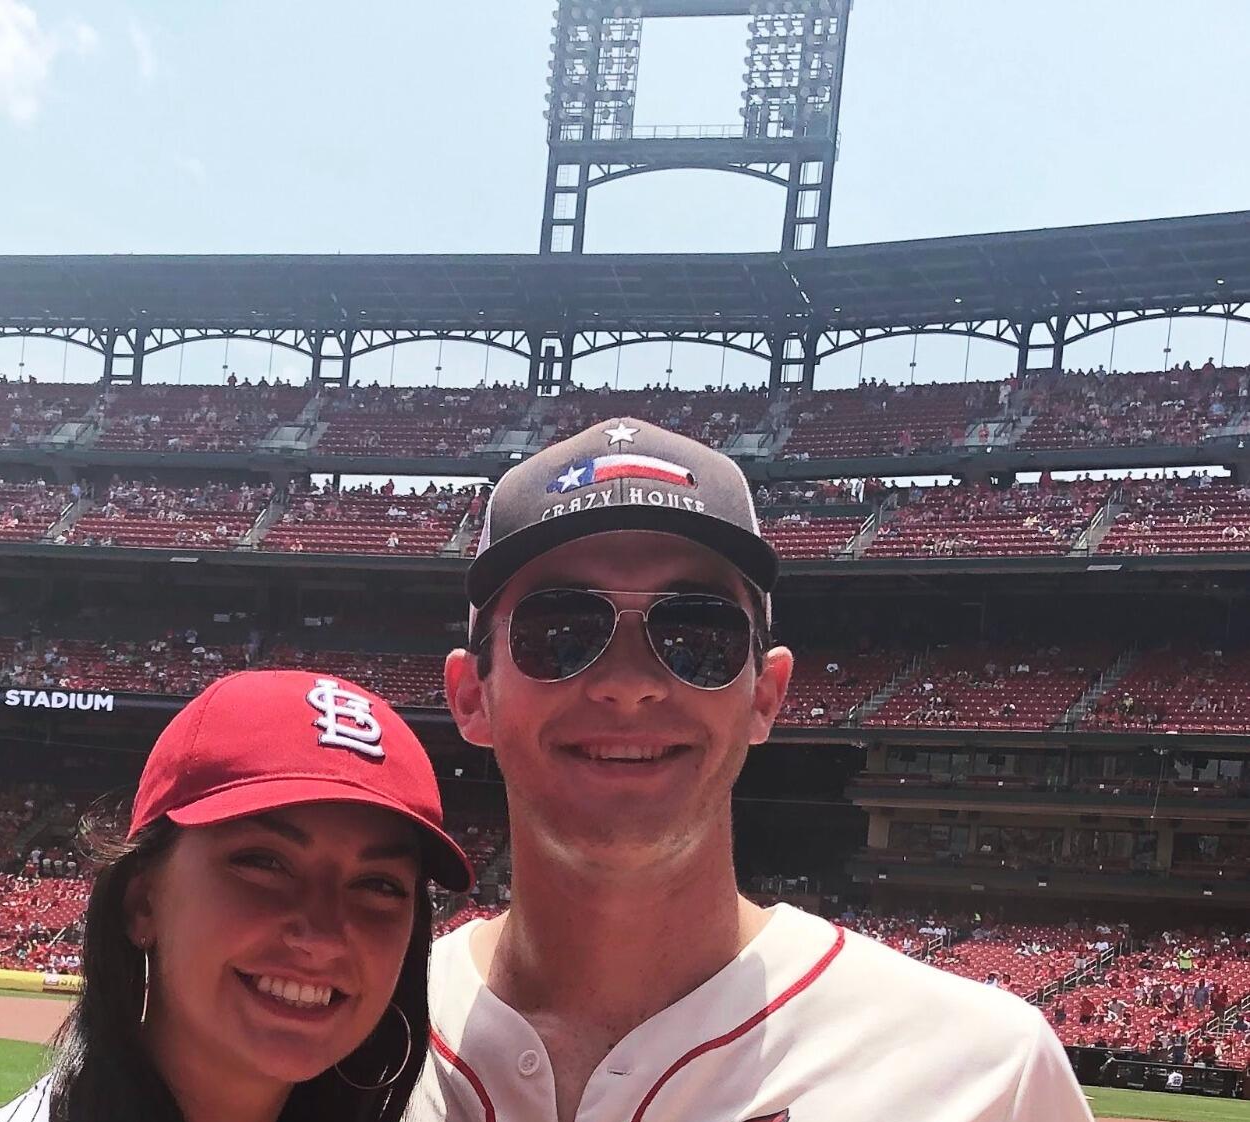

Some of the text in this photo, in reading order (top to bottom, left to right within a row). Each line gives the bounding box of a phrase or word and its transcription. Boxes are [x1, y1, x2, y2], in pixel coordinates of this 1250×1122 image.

[541, 487, 705, 521] CRAZY HOUSE
[5, 689, 114, 712] STADIUM
